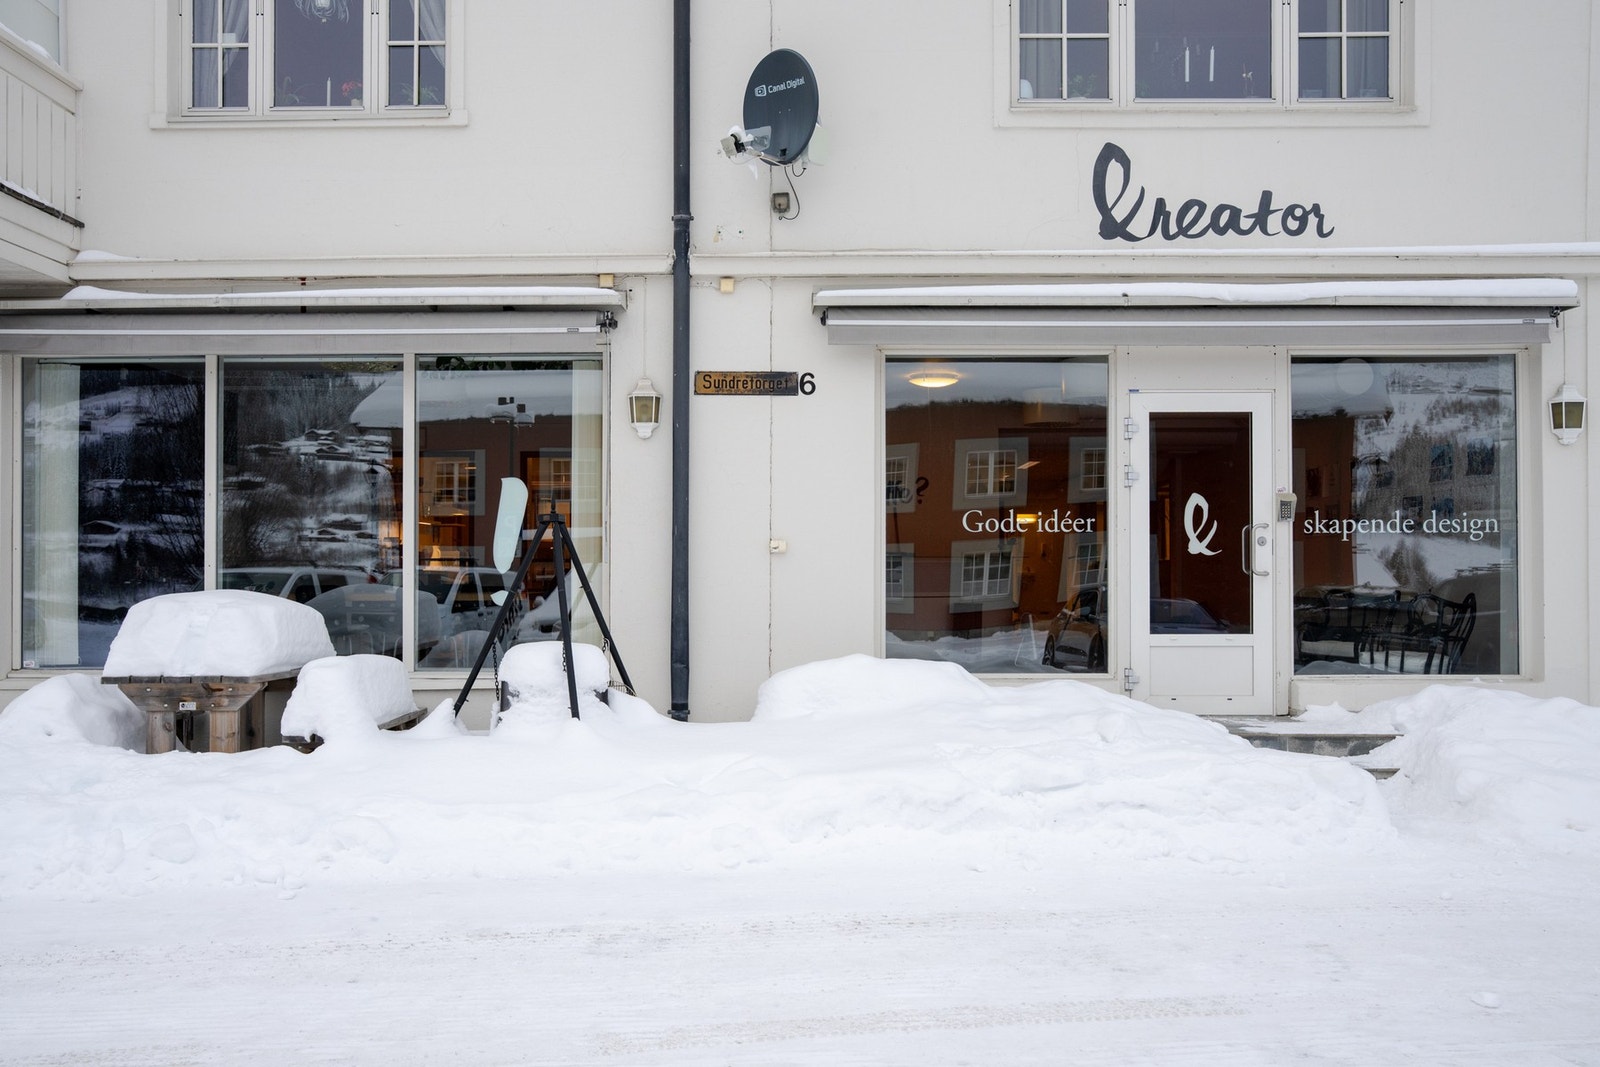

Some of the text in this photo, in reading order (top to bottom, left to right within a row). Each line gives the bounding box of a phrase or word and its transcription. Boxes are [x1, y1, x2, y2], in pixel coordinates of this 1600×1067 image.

[768, 76, 805, 93] Canal Digital
[702, 374, 789, 392] Sundretorget
[799, 371, 817, 396] 6
[961, 508, 1028, 534] Gode
[1036, 508, 1096, 534] idéer
[1302, 510, 1415, 542] skapende
[1422, 510, 1500, 542] design
